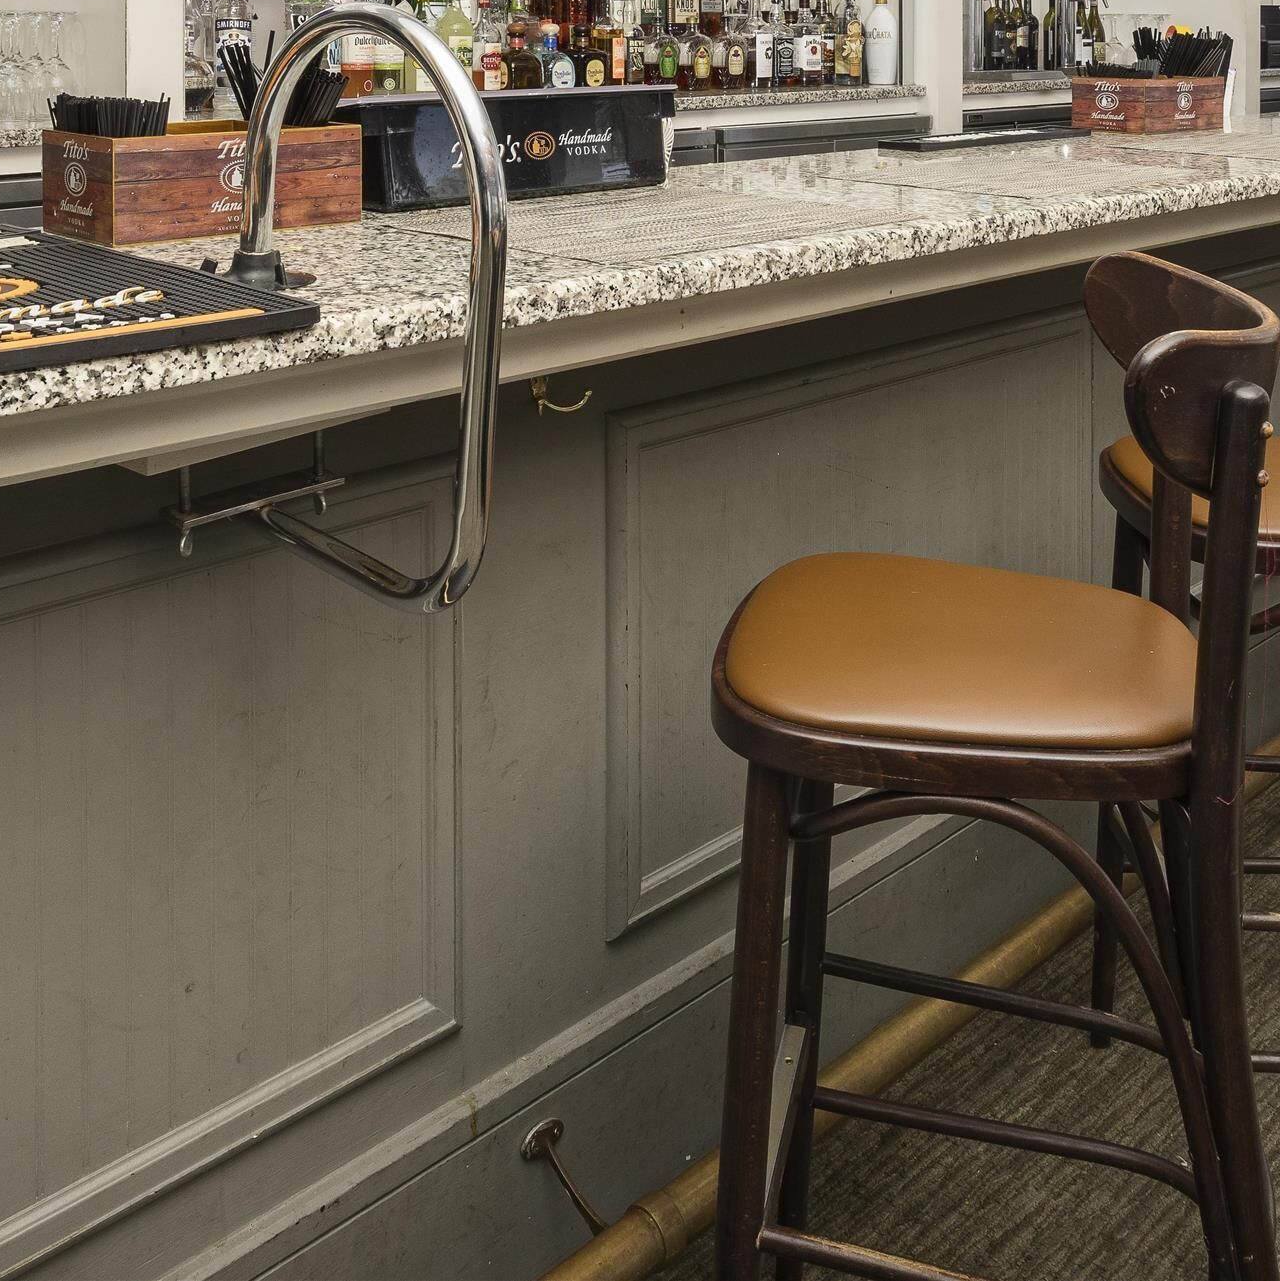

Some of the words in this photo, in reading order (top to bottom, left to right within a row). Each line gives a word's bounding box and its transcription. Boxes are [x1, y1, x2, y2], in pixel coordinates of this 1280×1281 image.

[676, 0, 693, 8] KNOB
[216, 21, 251, 29] SMIRNOFF
[1095, 81, 1121, 92] Tito's
[1177, 81, 1194, 92] Tito's
[1091, 111, 1125, 120] Handmade
[558, 127, 612, 146] Handmade
[566, 145, 607, 156] VODKA
[60, 196, 94, 217] Handmade
